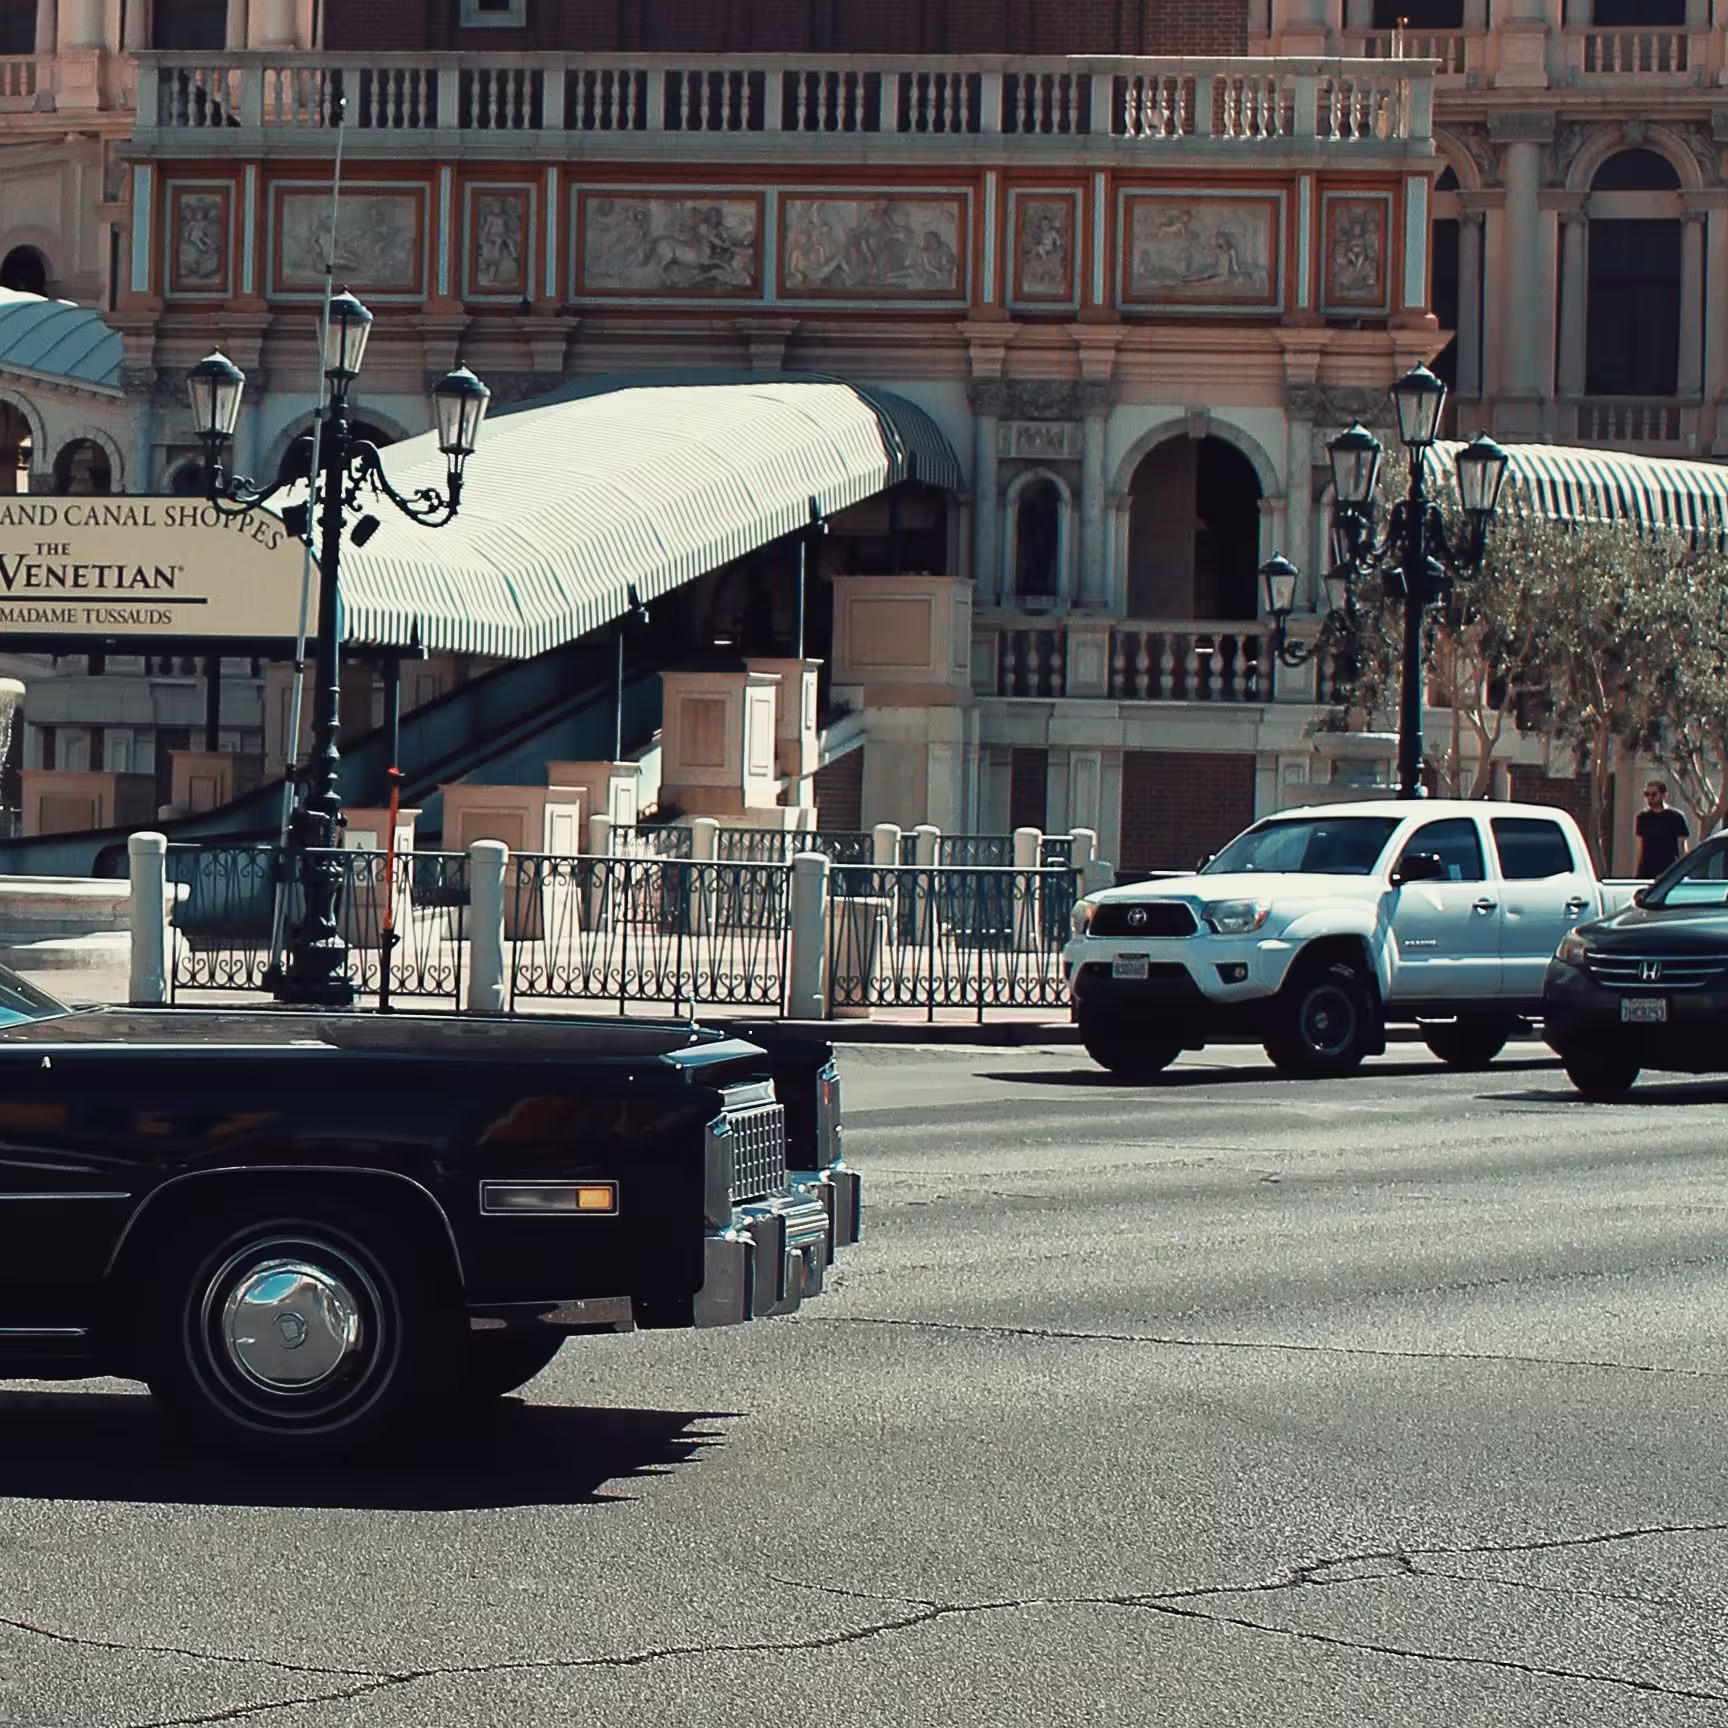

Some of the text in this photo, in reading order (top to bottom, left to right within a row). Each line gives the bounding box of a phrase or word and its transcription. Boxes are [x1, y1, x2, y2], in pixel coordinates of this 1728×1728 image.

[64, 504, 156, 527] CANAL
[163, 505, 284, 551] SHOPPES
[35, 542, 71, 556] THE
[0, 607, 172, 625] MADAME TUSSAUDS
